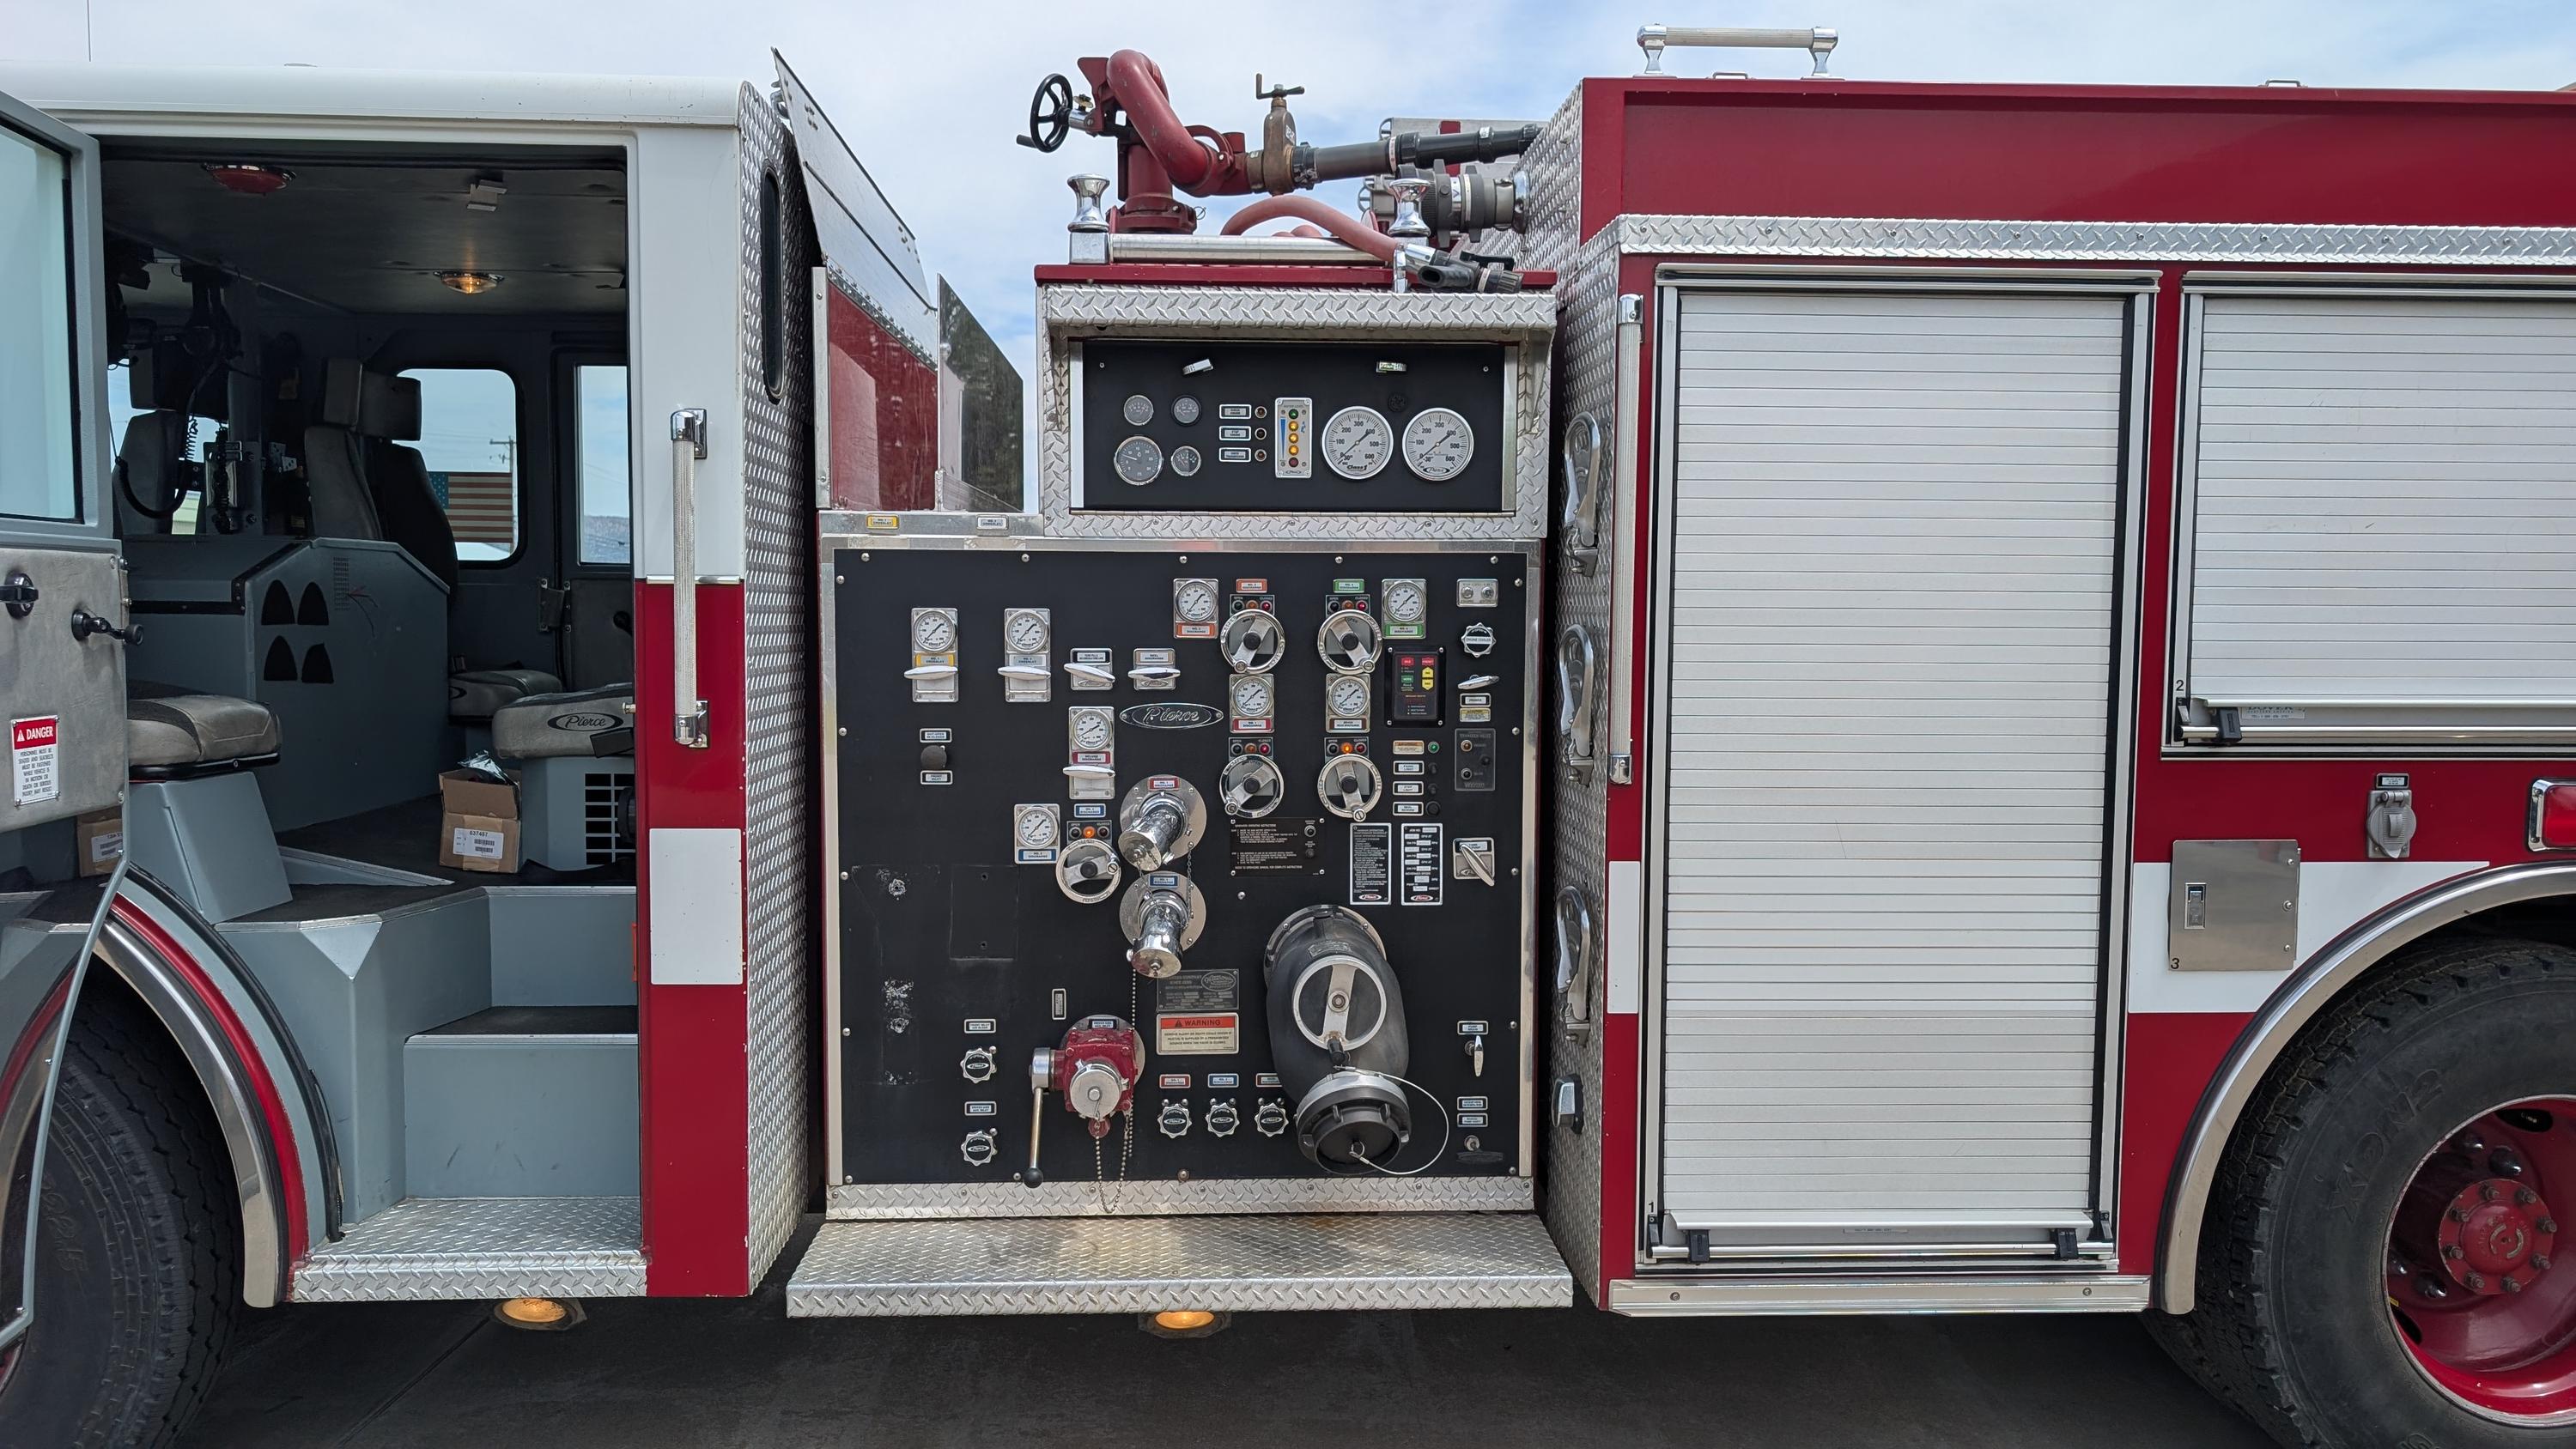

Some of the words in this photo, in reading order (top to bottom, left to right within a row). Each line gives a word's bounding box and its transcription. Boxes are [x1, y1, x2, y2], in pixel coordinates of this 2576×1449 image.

[2176, 680, 2184, 691] 2
[1142, 706, 1200, 724] Pierce
[565, 715, 606, 728] Pierce
[27, 726, 53, 740] DANGER
[2171, 958, 2179, 969] 3
[1649, 1201, 1654, 1213] 1
